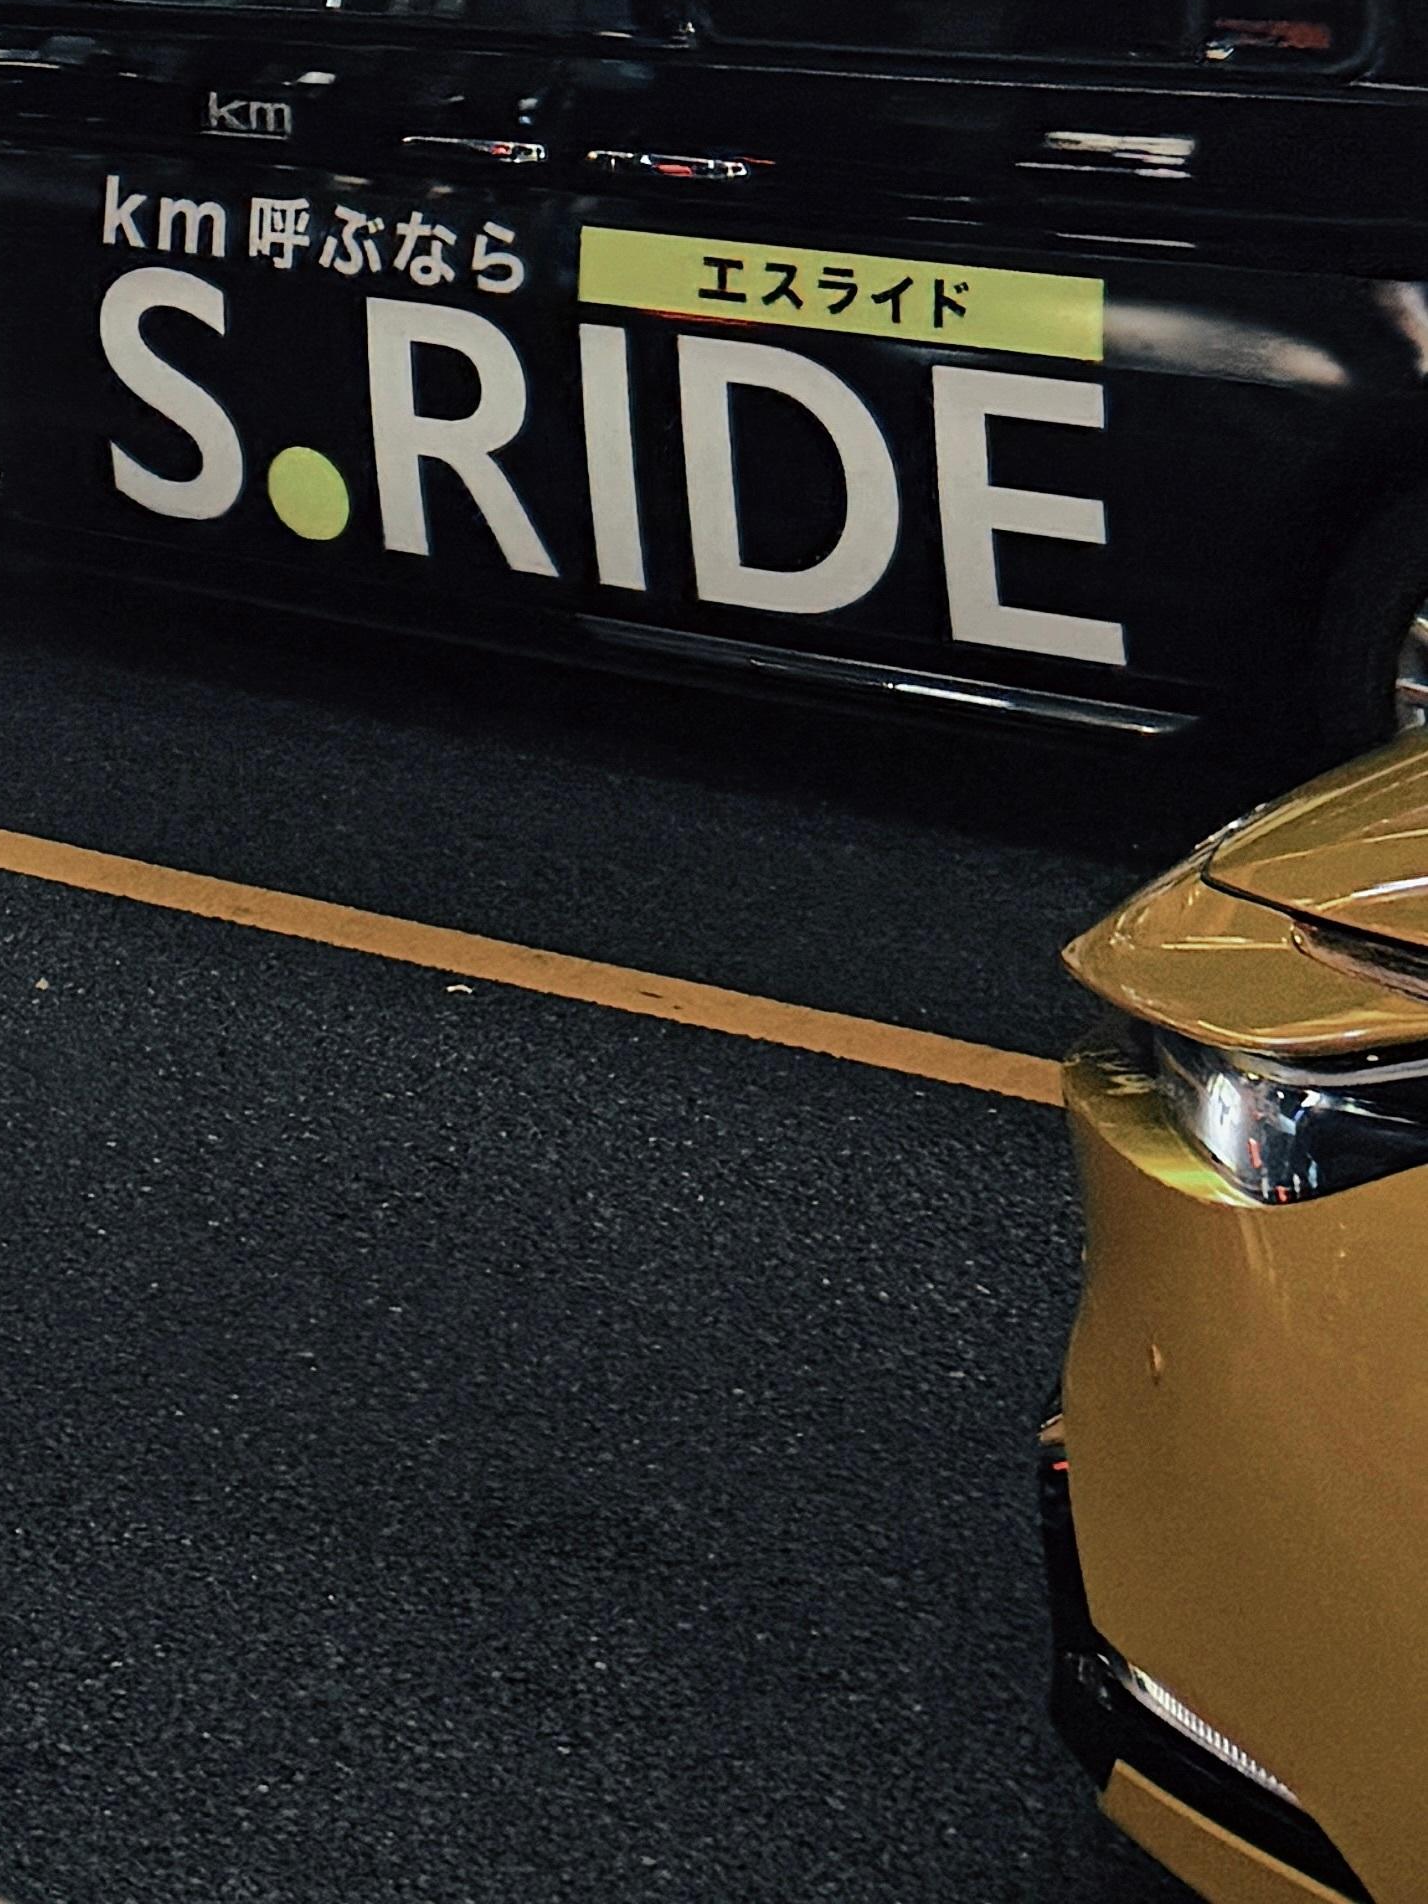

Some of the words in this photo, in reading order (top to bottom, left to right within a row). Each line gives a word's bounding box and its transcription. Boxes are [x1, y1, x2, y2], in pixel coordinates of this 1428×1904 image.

[207, 91, 293, 140] km
[697, 255, 971, 329] エスライド
[98, 265, 1128, 668] S.RIDE
